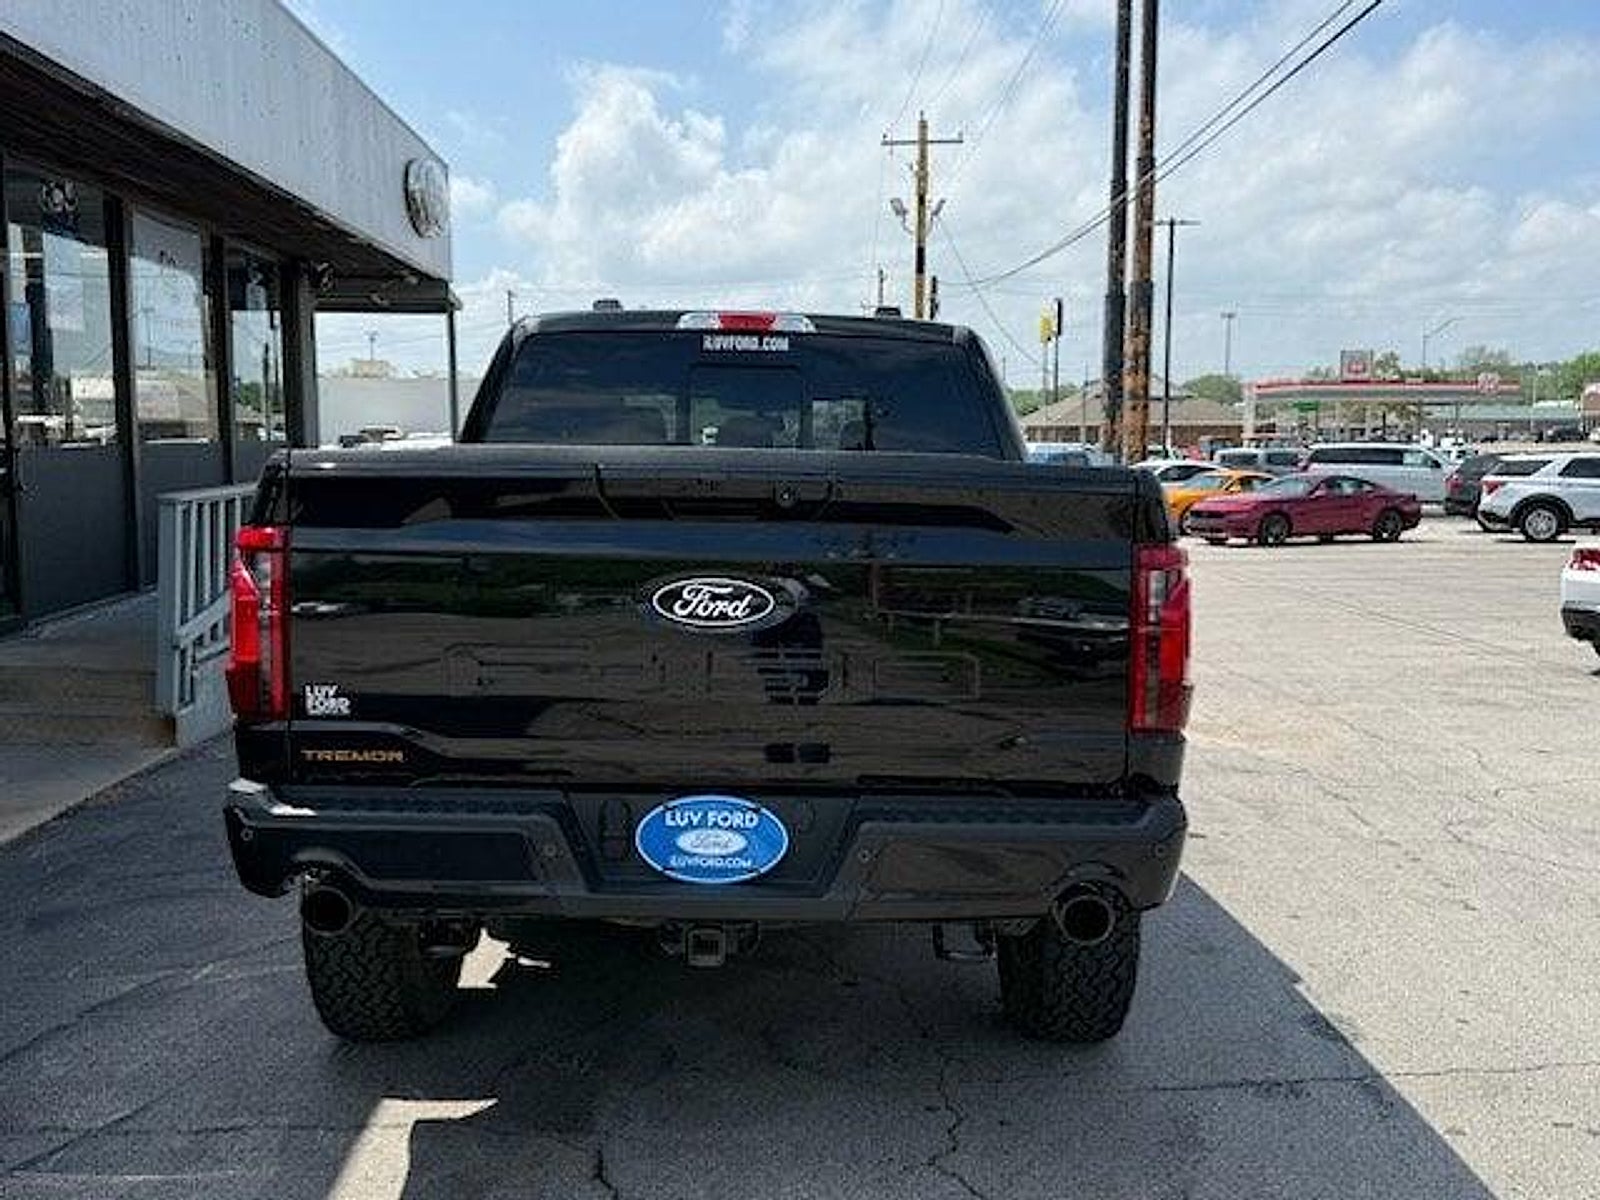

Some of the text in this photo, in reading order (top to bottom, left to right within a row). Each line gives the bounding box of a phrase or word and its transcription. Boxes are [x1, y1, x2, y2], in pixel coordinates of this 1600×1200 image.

[673, 585, 753, 619] Ford
[304, 685, 339, 699] LUV
[300, 750, 404, 763] TREMOR
[664, 809, 759, 828] LUV FORD
